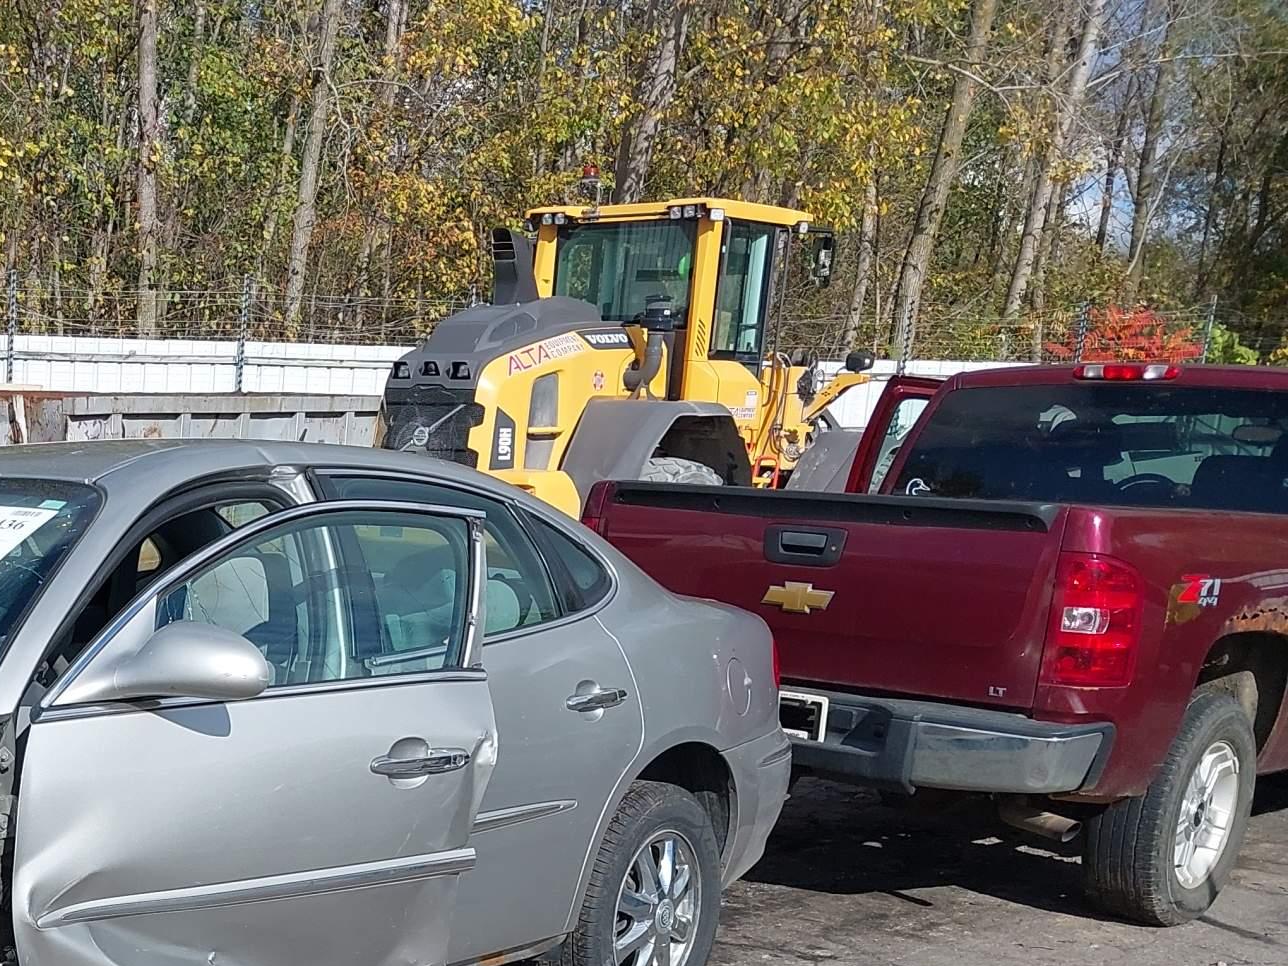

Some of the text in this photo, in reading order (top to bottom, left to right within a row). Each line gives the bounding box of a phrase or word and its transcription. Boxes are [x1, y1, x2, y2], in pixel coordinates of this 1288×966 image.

[543, 334, 580, 351] EQUIPMENT
[584, 333, 628, 345] VOLVO
[550, 343, 585, 359] COMPANY
[508, 344, 551, 377] ALTA
[497, 427, 513, 461] L90H
[1176, 573, 1221, 603] Z71
[988, 686, 1007, 698] LT
